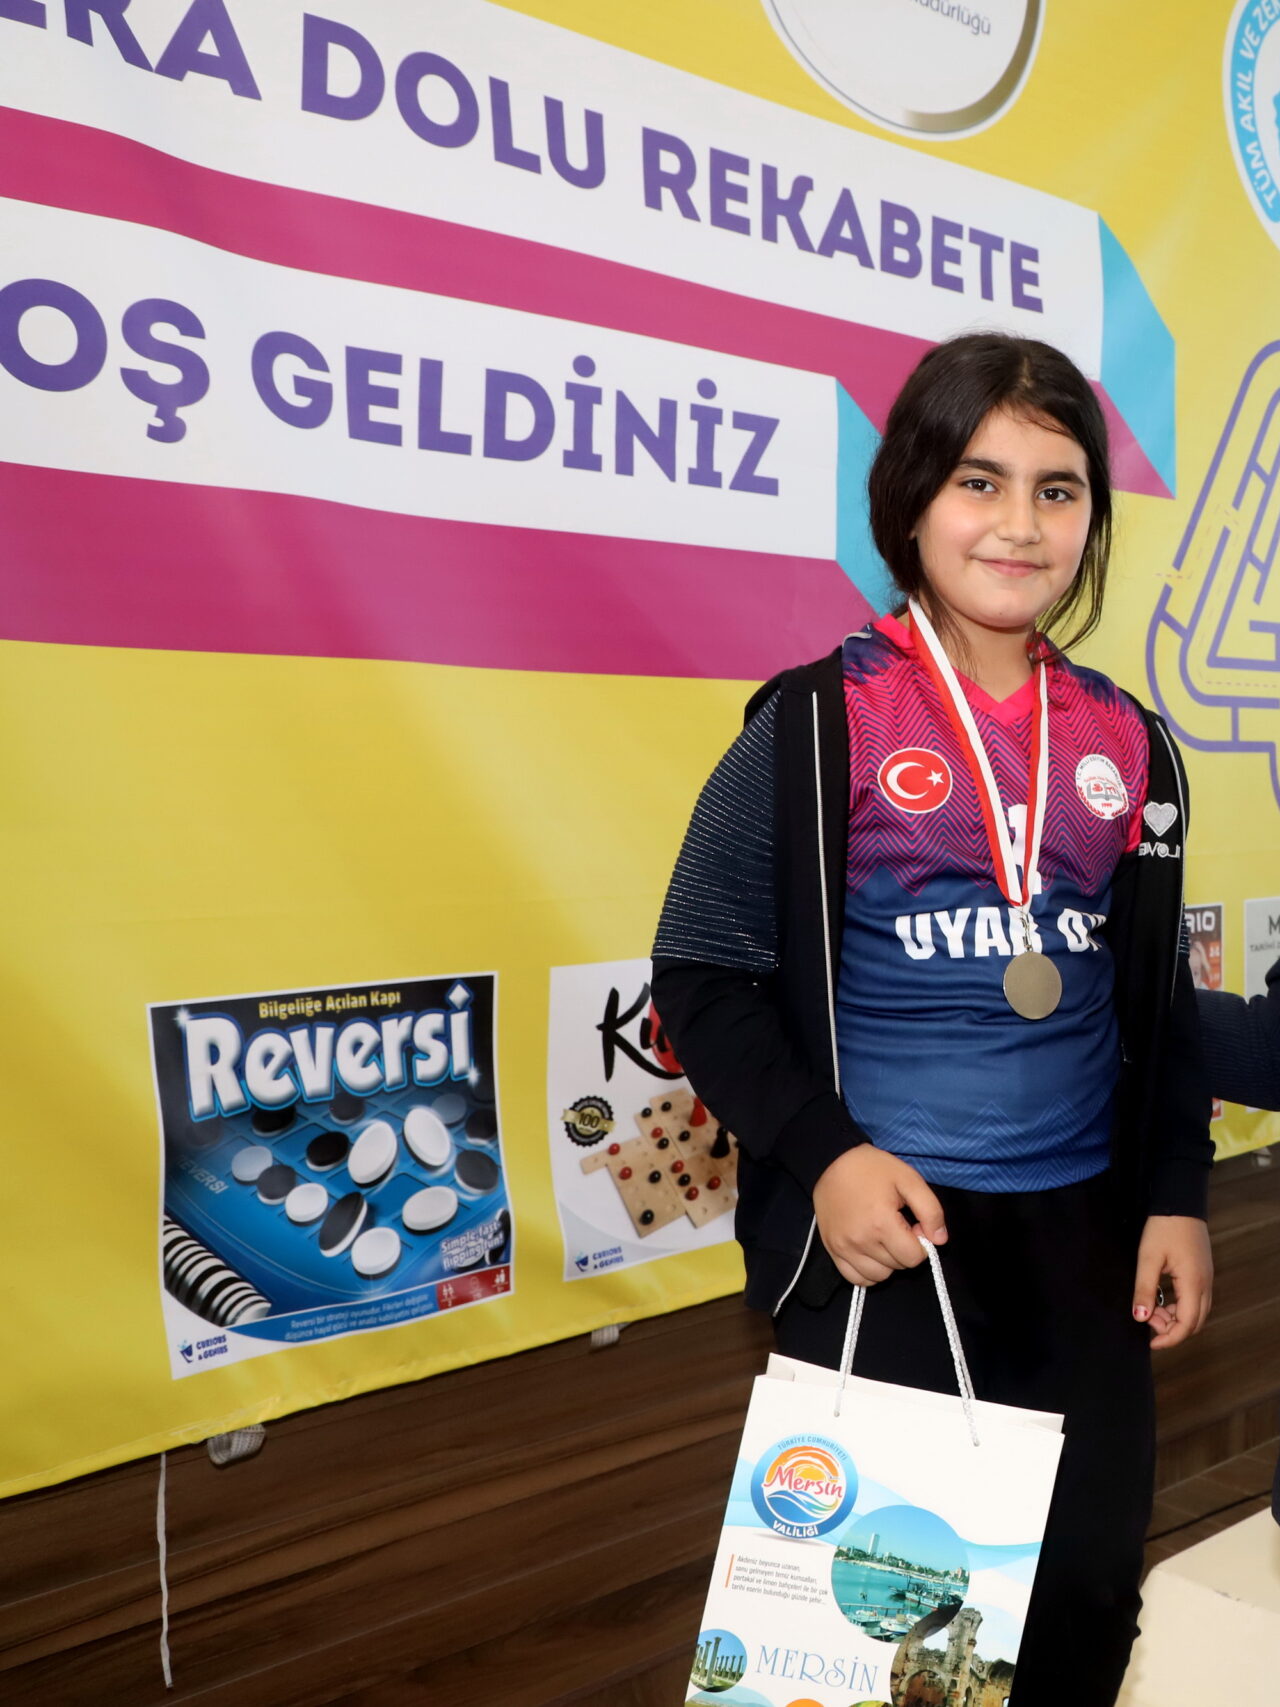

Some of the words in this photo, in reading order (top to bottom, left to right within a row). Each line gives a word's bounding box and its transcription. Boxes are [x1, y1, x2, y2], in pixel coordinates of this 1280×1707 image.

[1240, 23, 1260, 59] VE
[1237, 71, 1256, 132] AKIL
[301, 12, 606, 190] DOLU
[641, 126, 1044, 313] REKABETE
[1246, 141, 1279, 208] TÜM
[251, 330, 780, 497] GELDİNİZ
[259, 997, 322, 1020] Bilgeliğe
[326, 993, 367, 1014] Açılan
[370, 991, 401, 1008] Kapı
[184, 981, 471, 1119] Reversi
[773, 1520, 818, 1537] VALİLİĞİ
[756, 1645, 879, 1695] MERSİN
